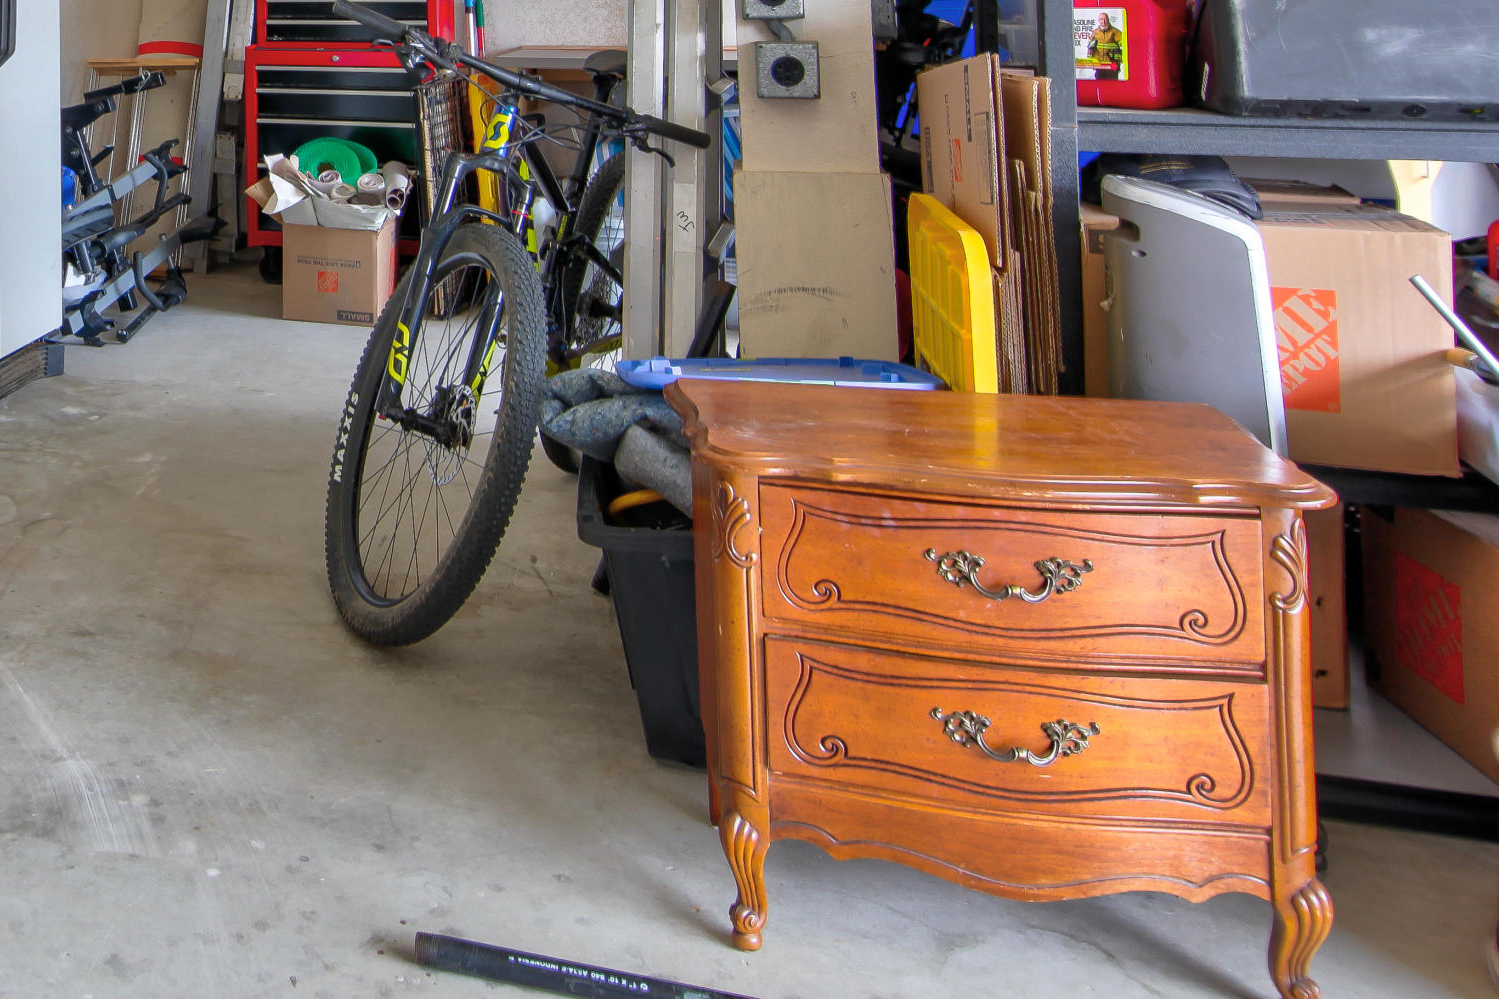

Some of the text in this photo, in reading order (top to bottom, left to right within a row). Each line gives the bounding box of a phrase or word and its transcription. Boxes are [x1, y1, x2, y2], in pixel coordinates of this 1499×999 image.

[1073, 18, 1096, 26] ASOLINE
[340, 312, 370, 321] SMALL
[1281, 335, 1339, 395] EPOT
[333, 393, 359, 483] MAXXIS
